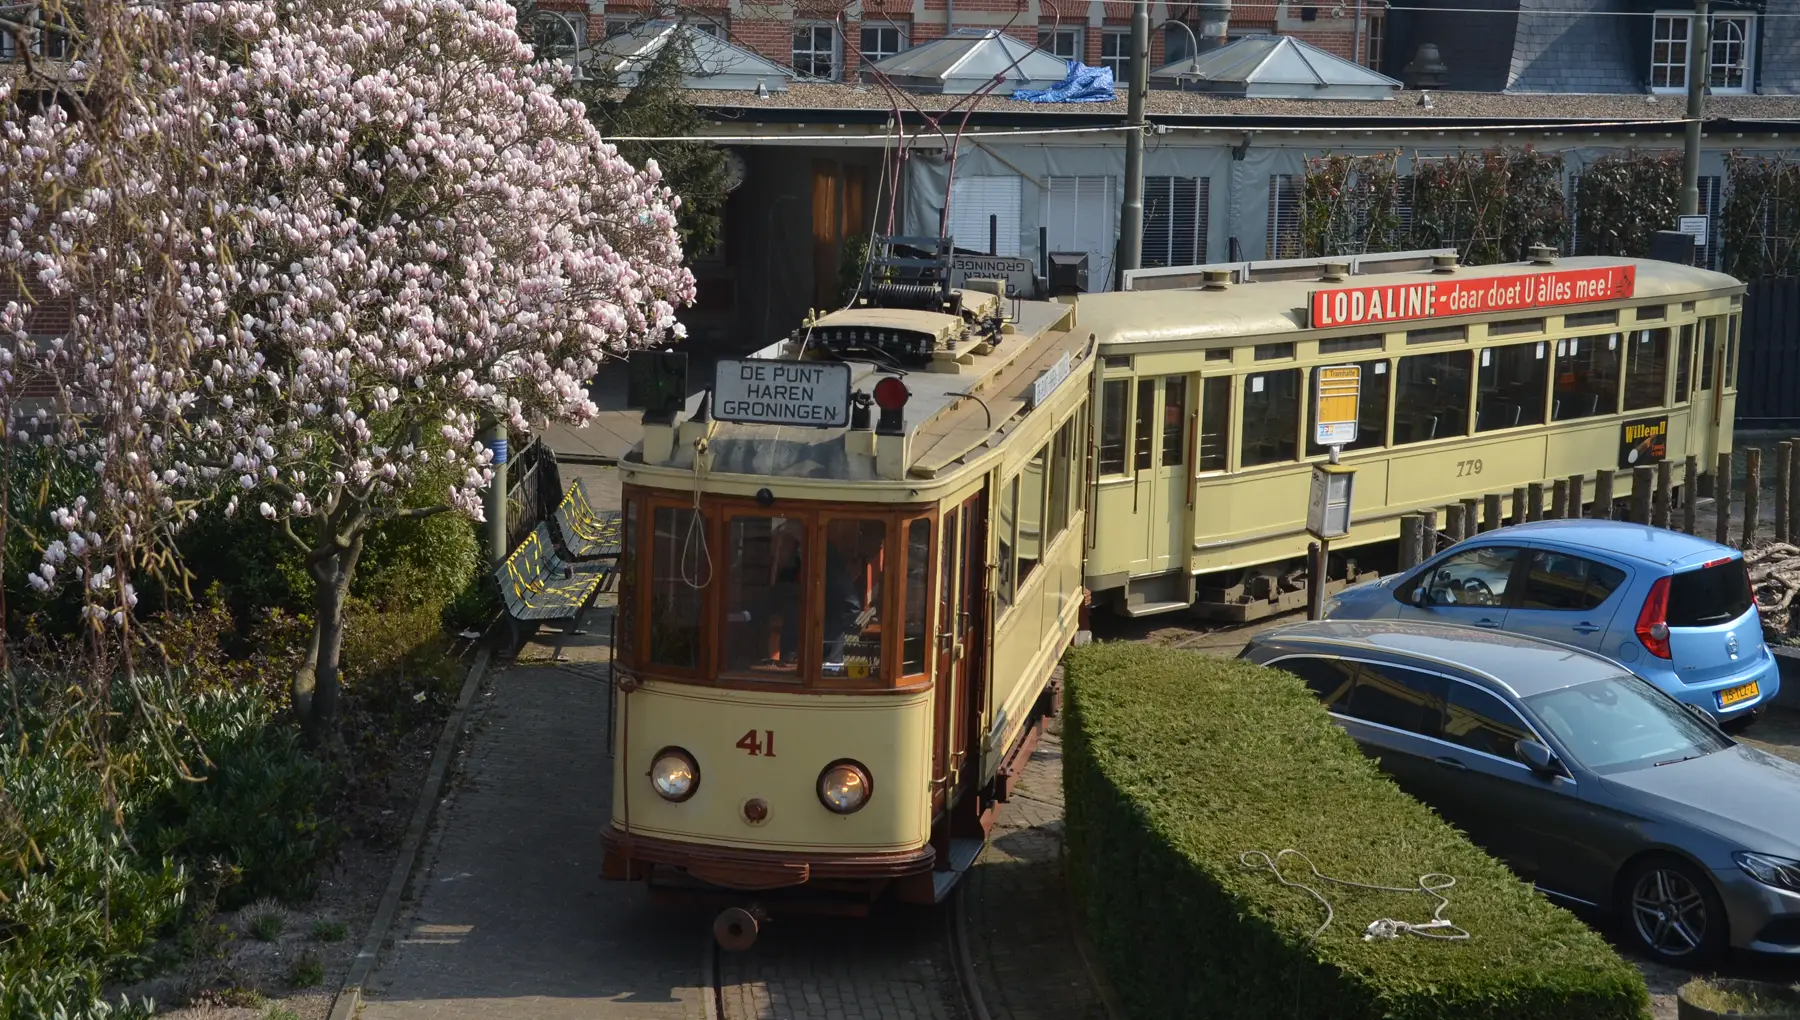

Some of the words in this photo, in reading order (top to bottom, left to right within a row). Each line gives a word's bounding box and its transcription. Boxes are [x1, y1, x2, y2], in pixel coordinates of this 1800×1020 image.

[1487, 280, 1521, 307] doet
[1525, 277, 1535, 304] U
[1576, 270, 1612, 299] mee!
[740, 365, 766, 381] DE
[773, 366, 824, 385] PUNT
[747, 383, 814, 401] HAREN
[723, 400, 836, 420] GRONINGEN
[1625, 424, 1659, 443] Willem
[1456, 458, 1483, 478] 779
[736, 729, 776, 757] 41
